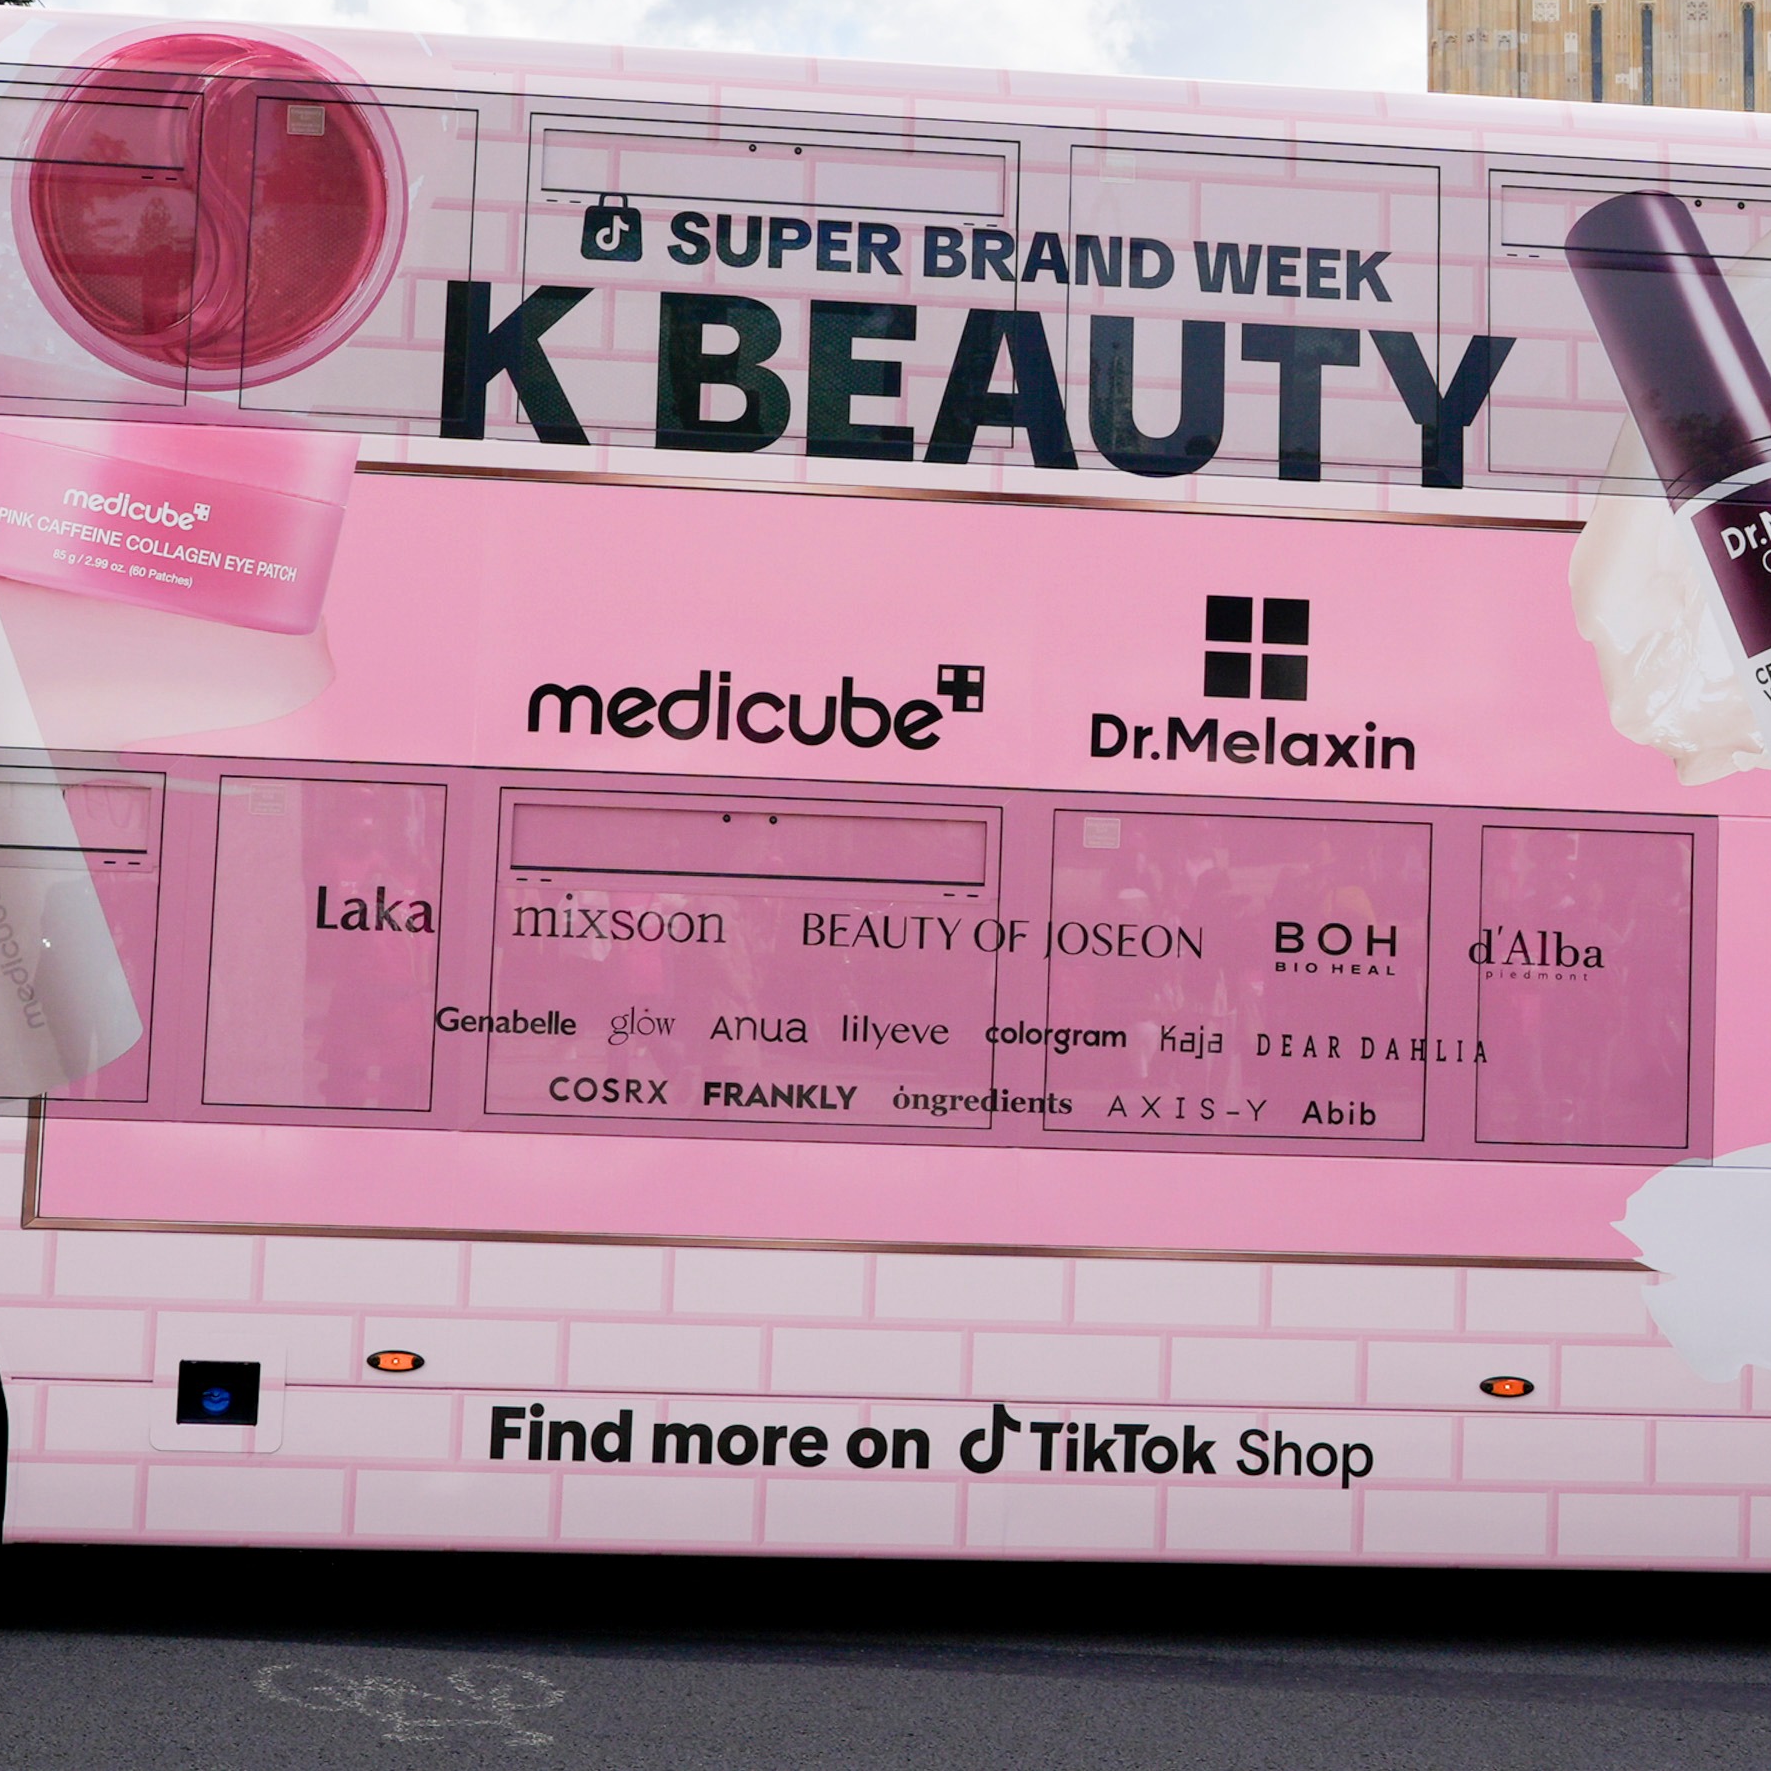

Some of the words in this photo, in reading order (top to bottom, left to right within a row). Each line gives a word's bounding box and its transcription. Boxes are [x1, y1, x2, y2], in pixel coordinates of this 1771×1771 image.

[666, 209, 902, 278] SUPER
[921, 225, 1176, 292] BRAND
[1191, 240, 1393, 304] WEEK
[439, 279, 592, 448] K
[656, 290, 1518, 491] BEAUTY
[62, 487, 195, 531] medicube
[36, 515, 123, 548] CAFFEINE
[125, 534, 222, 569] COLLAGEN
[223, 554, 254, 575] EYE
[256, 561, 298, 583] PATCH
[52, 548, 67, 561] 85
[84, 555, 109, 570] 2.99
[147, 568, 193, 589] Patches)
[527, 669, 944, 752] medicube
[1090, 712, 1417, 772] Dr.Melaxin
[316, 885, 435, 933] Laka
[512, 892, 727, 944] mixsoon
[802, 912, 962, 952] BEAUTY
[972, 918, 1030, 954] OF
[1043, 919, 1204, 961] JOSEON
[1274, 920, 1398, 958] BOH
[1468, 925, 1605, 970] d'Alba
[1274, 961, 1318, 974] BIO
[1331, 963, 1396, 976] HEAL
[1485, 968, 1589, 983] piedmont
[435, 1005, 577, 1036] Genabelle
[709, 1014, 808, 1044] Anua
[842, 1014, 950, 1050] lilyeve
[985, 1020, 1127, 1055] colorgram
[1161, 1024, 1222, 1060] Kaja
[1256, 1032, 1341, 1059] DEAR
[1360, 1036, 1488, 1064] DAHLIA
[548, 1075, 668, 1105] COSRX
[703, 1080, 859, 1110] FRANKLY
[1301, 1099, 1377, 1126] Abib
[489, 1402, 634, 1463] Find
[652, 1423, 829, 1469] more
[845, 1427, 929, 1470] on
[1030, 1420, 1218, 1477] TikTok
[1235, 1428, 1375, 1490] Shop
